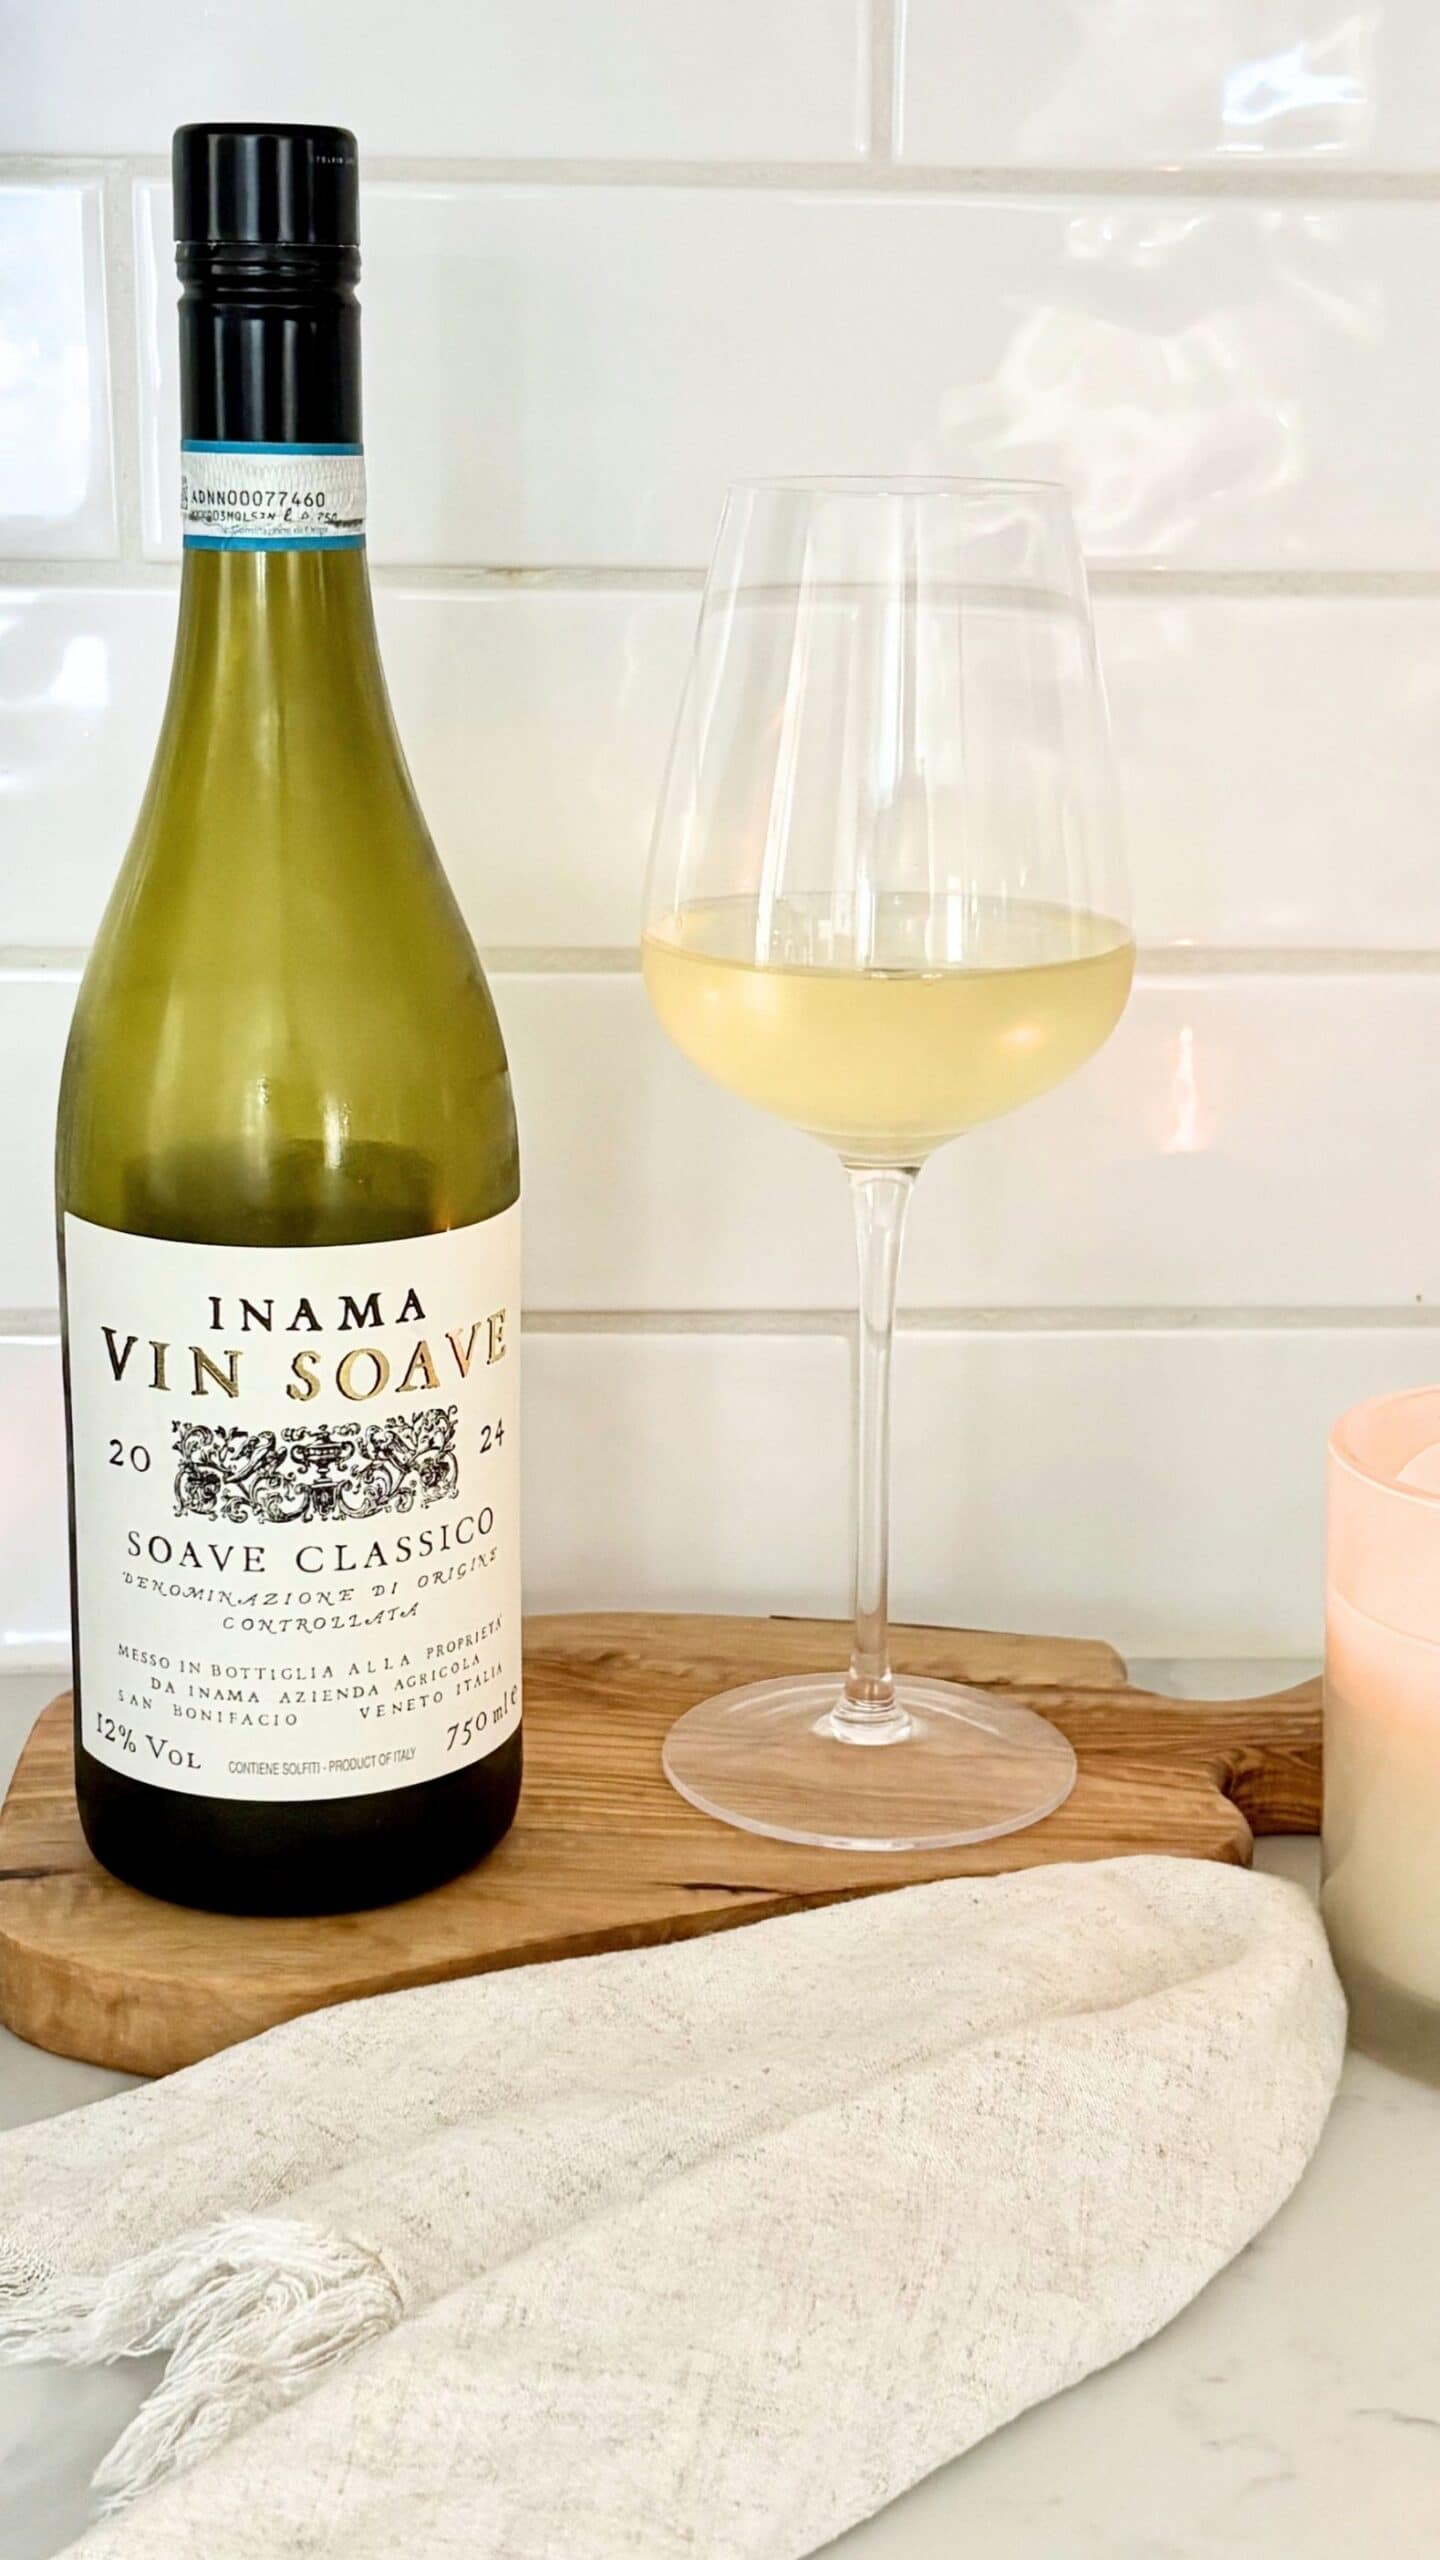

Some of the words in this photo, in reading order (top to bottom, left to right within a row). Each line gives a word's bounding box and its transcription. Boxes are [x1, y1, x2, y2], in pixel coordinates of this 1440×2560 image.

[208, 1287, 426, 1332] INAMA
[101, 1326, 244, 1399] VIN
[286, 1308, 506, 1401] SOAVE
[480, 1416, 505, 1454] 24
[109, 1439, 151, 1473] 20
[128, 1531, 266, 1572] SOAVE
[296, 1507, 494, 1573] CLASSICO
[122, 1571, 354, 1607] DENOMINAZIONE
[371, 1582, 398, 1597] DI
[417, 1547, 497, 1588] ORIGINE
[223, 1602, 419, 1634] CONTROLLATA
[118, 1643, 170, 1669] MESSO
[180, 1660, 200, 1673] IN
[211, 1664, 334, 1682] BOTTIGLIA
[349, 1654, 410, 1676] ALLA
[151, 1677, 175, 1694] DA
[189, 1685, 260, 1702] INAMA
[279, 1685, 379, 1704] AZIENDA
[394, 1653, 480, 1691] AGRICOLA
[118, 1690, 152, 1710] SAN
[173, 1704, 297, 1726] BONIFACIO
[359, 1691, 443, 1719] VENETO
[456, 1662, 503, 1696] ITALIA
[96, 1712, 137, 1753] 12%
[446, 1711, 488, 1751] 750
[228, 1761, 281, 1775] CONTIENE
[281, 1762, 320, 1776] SOLFITI
[329, 1754, 377, 1773] PRODUCT
[379, 1752, 392, 1767] OF
[393, 1747, 417, 1764] ITALY
